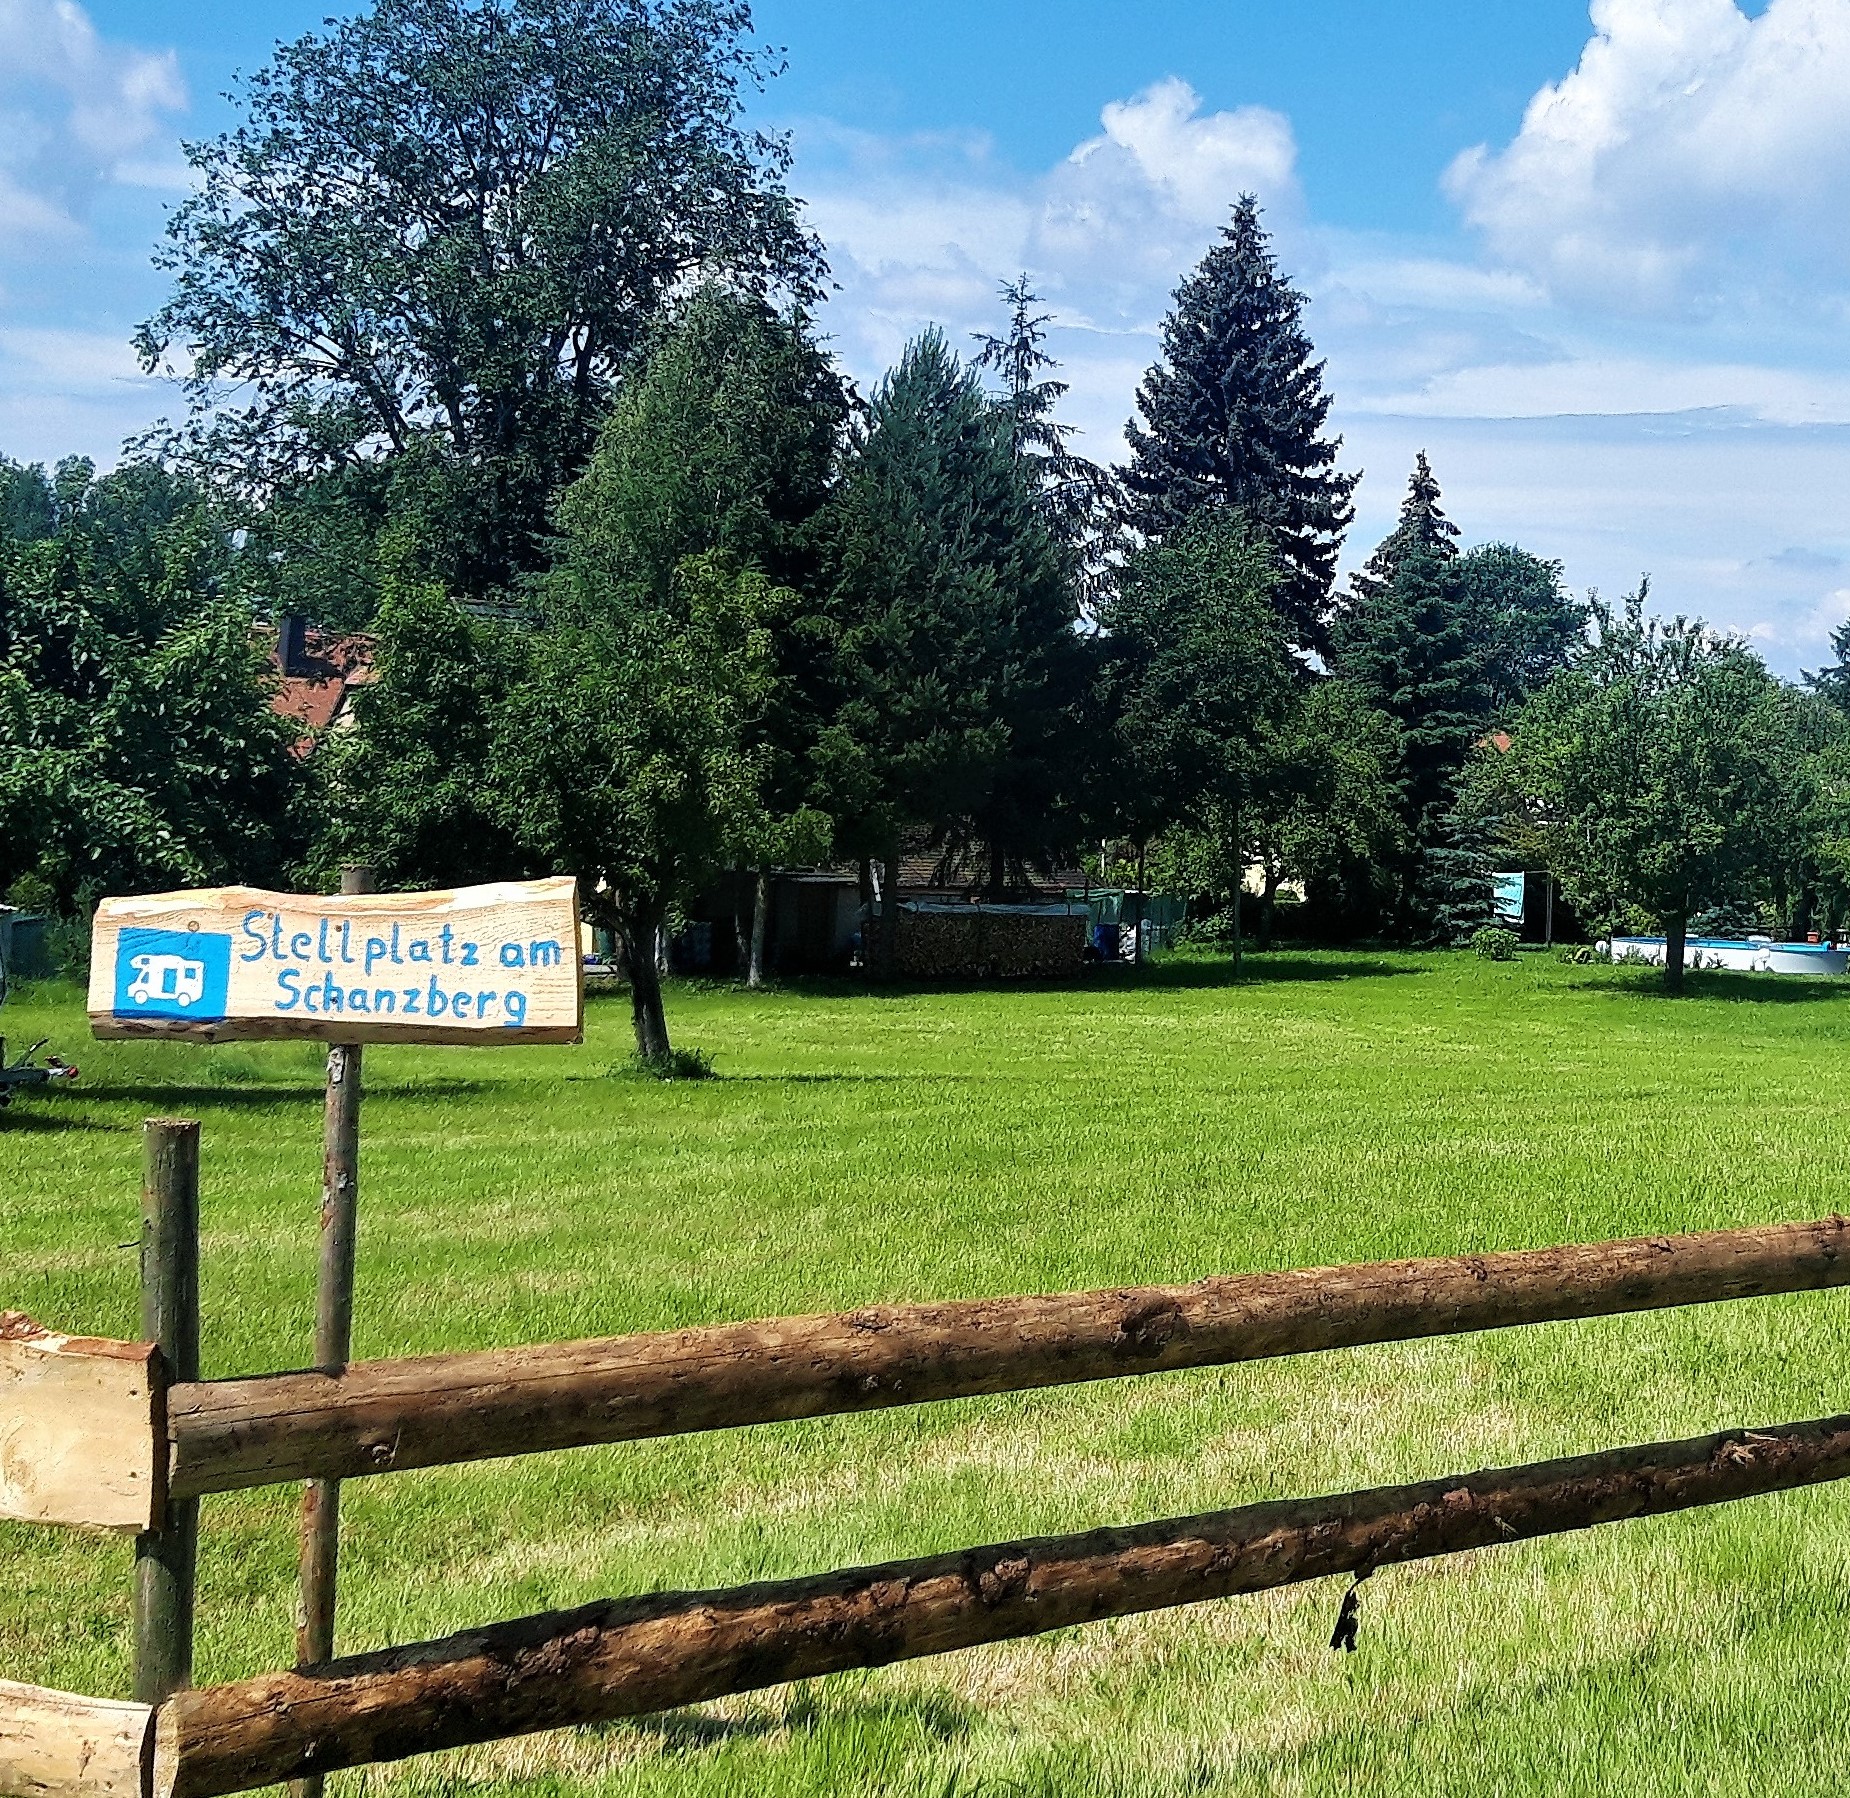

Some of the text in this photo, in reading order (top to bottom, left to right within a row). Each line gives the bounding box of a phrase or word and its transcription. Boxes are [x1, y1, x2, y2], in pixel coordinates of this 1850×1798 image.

[240, 909, 563, 977] Stellplatz am
[274, 968, 527, 1028] Schanzberg
